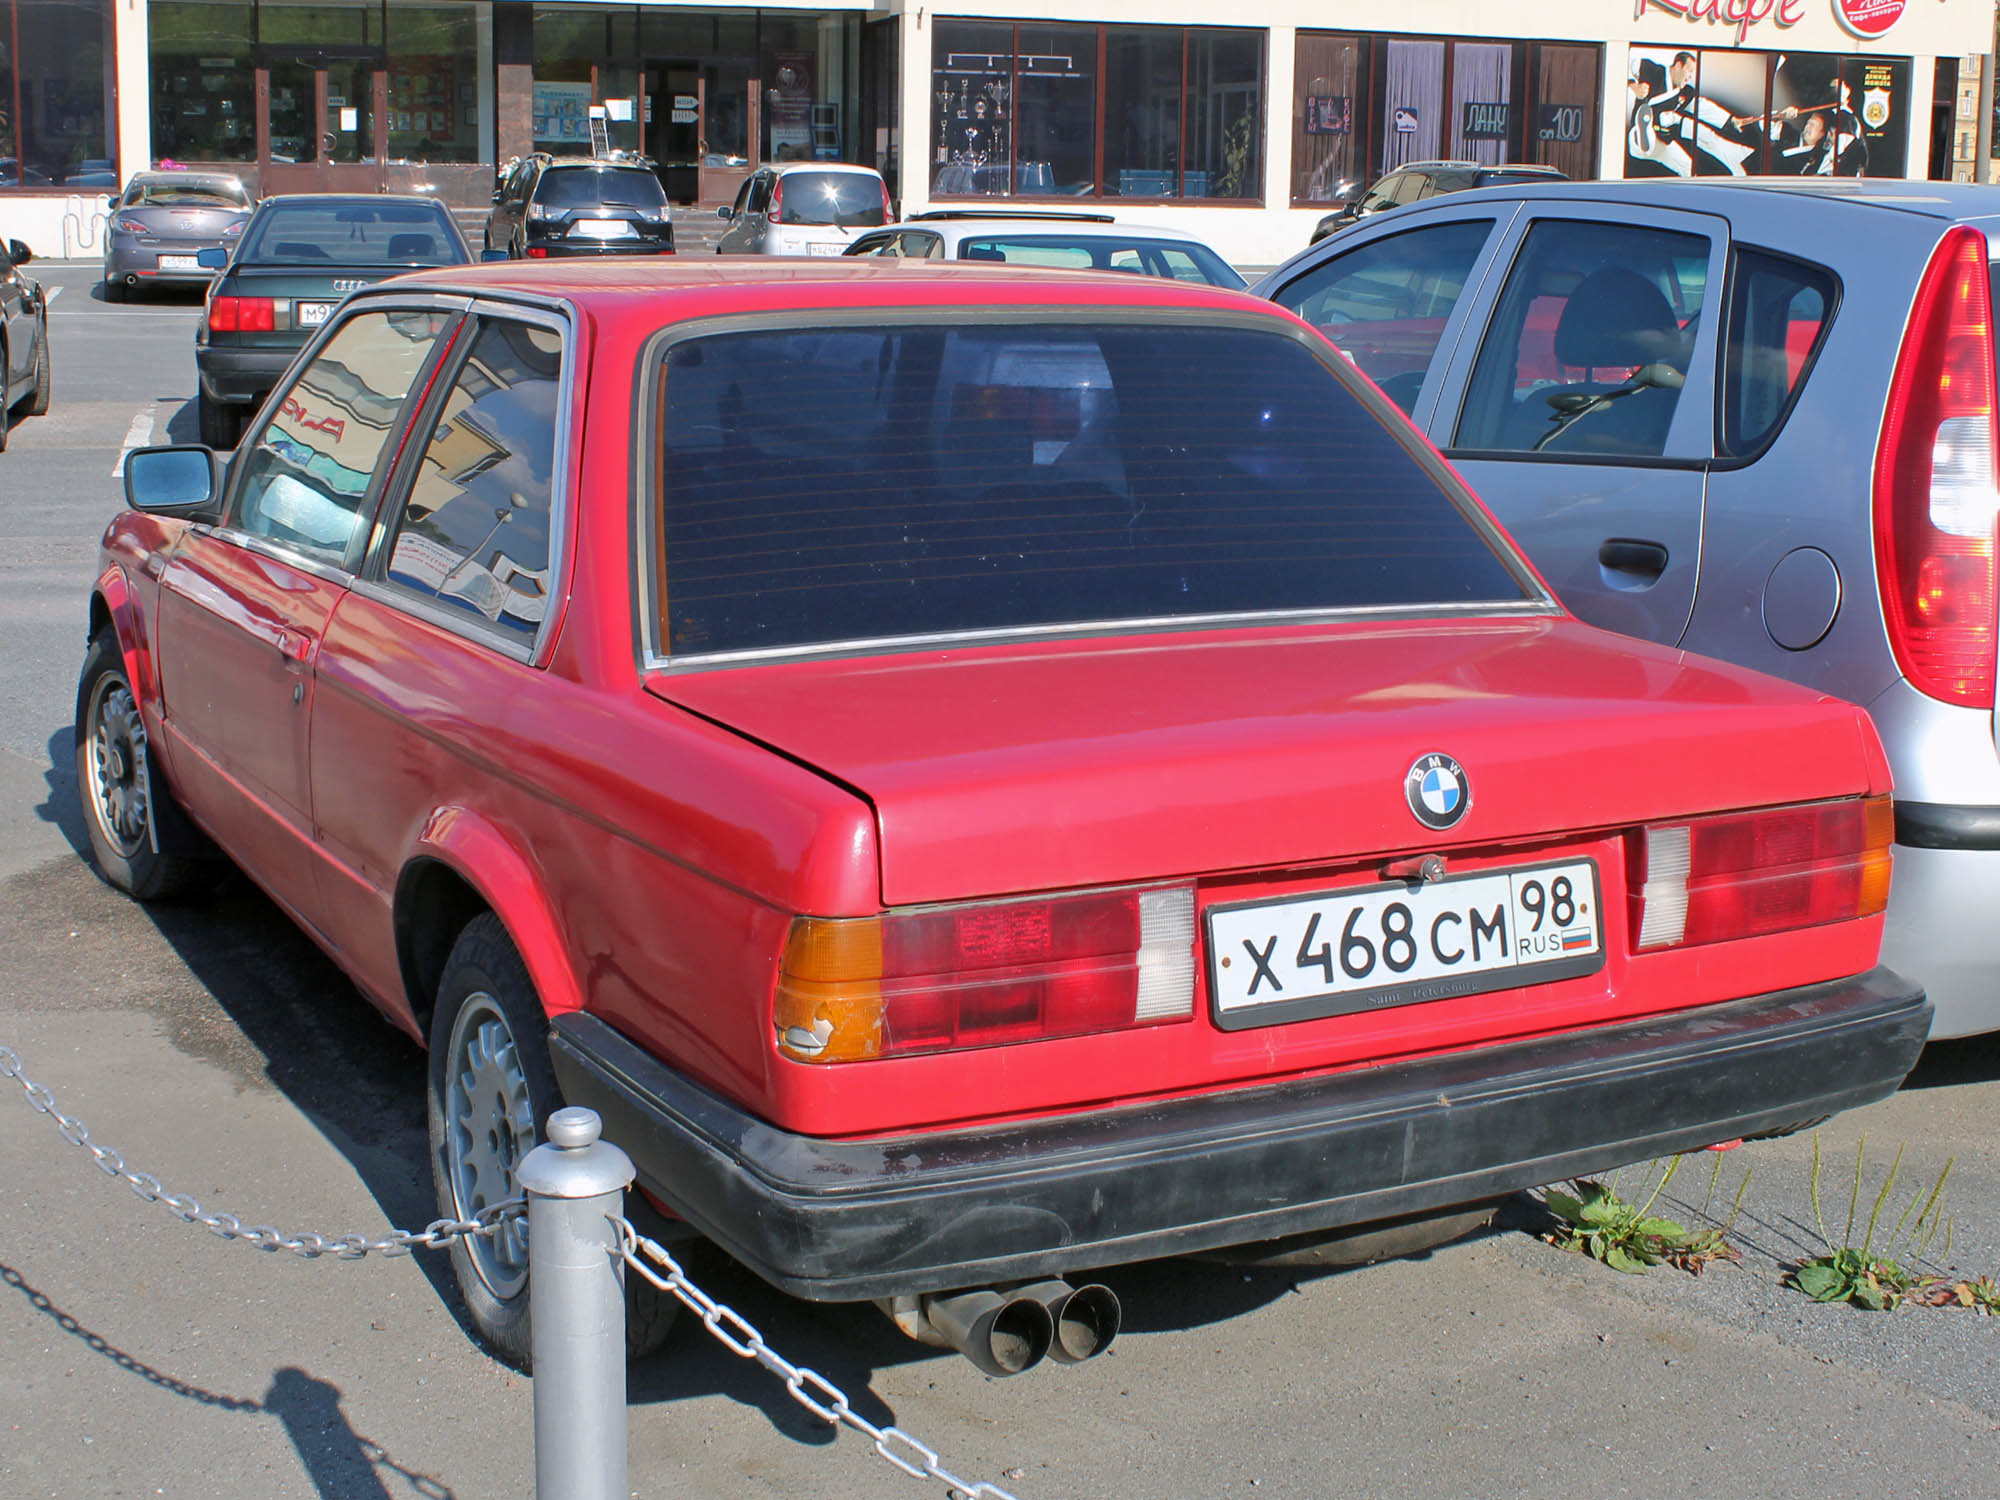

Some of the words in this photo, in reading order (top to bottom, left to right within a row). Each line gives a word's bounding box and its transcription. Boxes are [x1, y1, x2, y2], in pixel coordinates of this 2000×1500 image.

[1552, 107, 1582, 139] 100
[1411, 755, 1462, 782] BMW
[1519, 875, 1575, 932] 98
[1519, 938, 1561, 956] RUS
